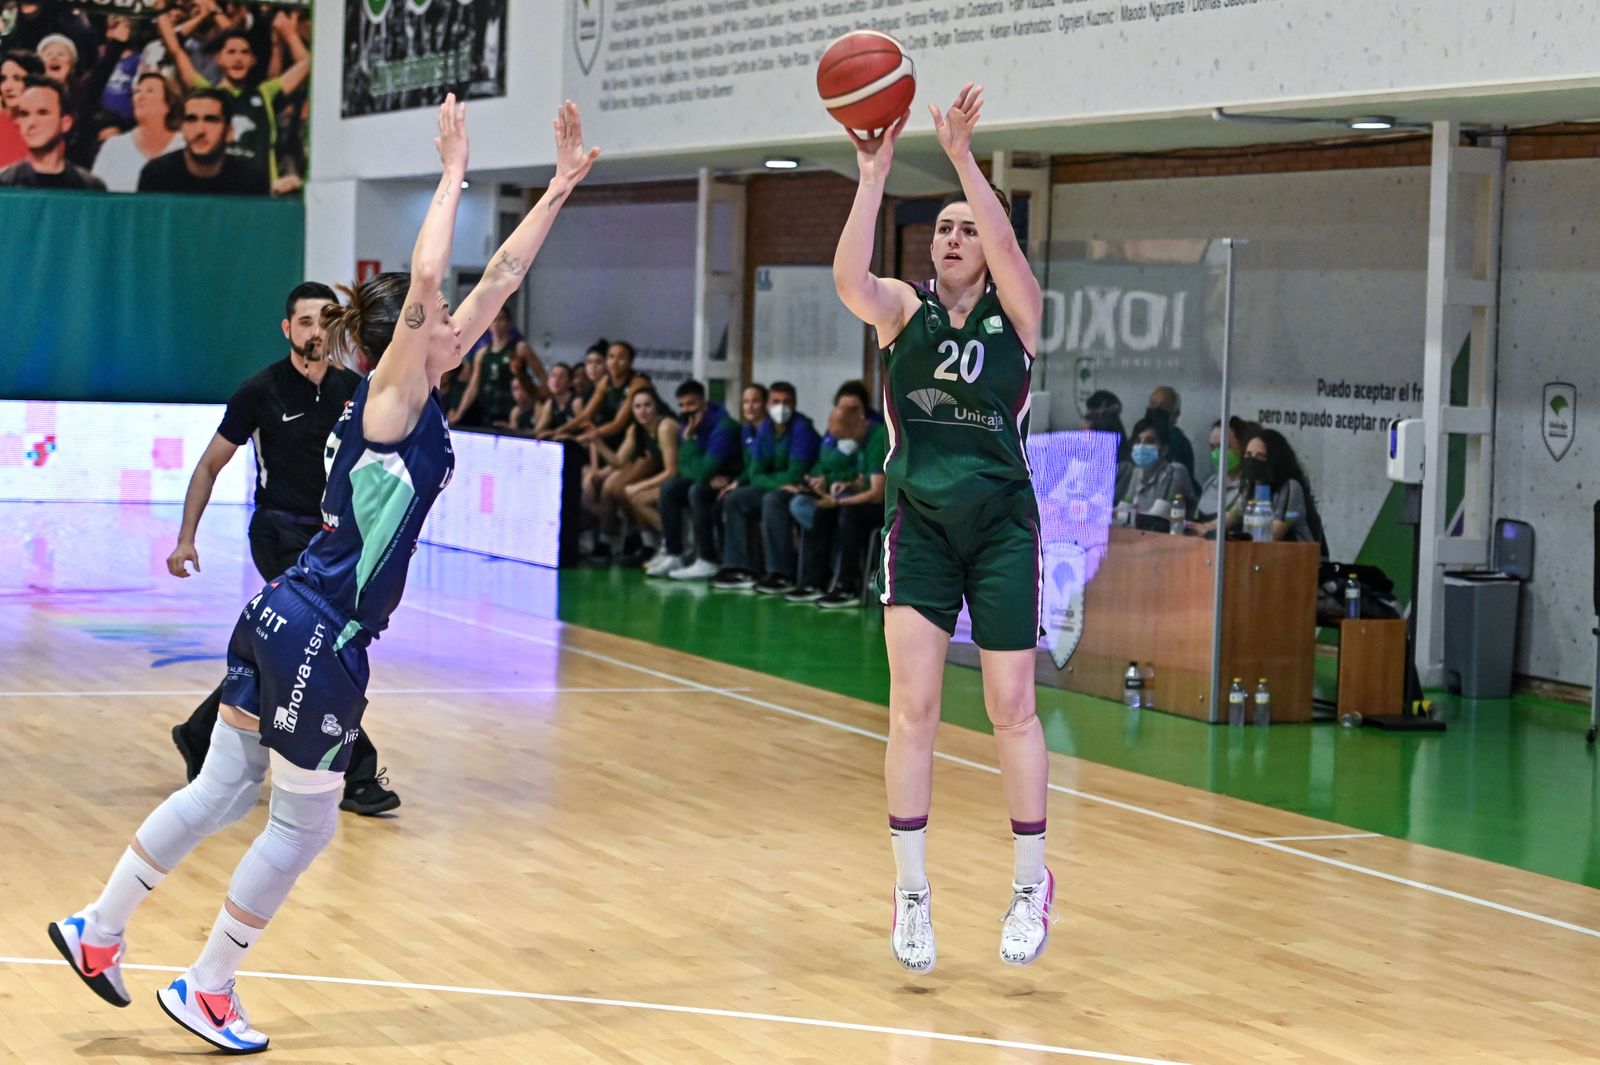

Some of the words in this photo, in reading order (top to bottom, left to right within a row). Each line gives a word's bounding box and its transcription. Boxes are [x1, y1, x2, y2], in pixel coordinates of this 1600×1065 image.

[934, 340, 985, 384] 20
[1317, 378, 1351, 399] Puedo
[1353, 382, 1396, 405] aceptar
[1398, 382, 1410, 402] el
[1412, 382, 1424, 402] fr
[1258, 409, 1281, 424] pero
[1284, 411, 1298, 425] no
[1300, 408, 1333, 430] puedo
[1335, 412, 1377, 435] aceptar
[259, 606, 288, 633] FIT
